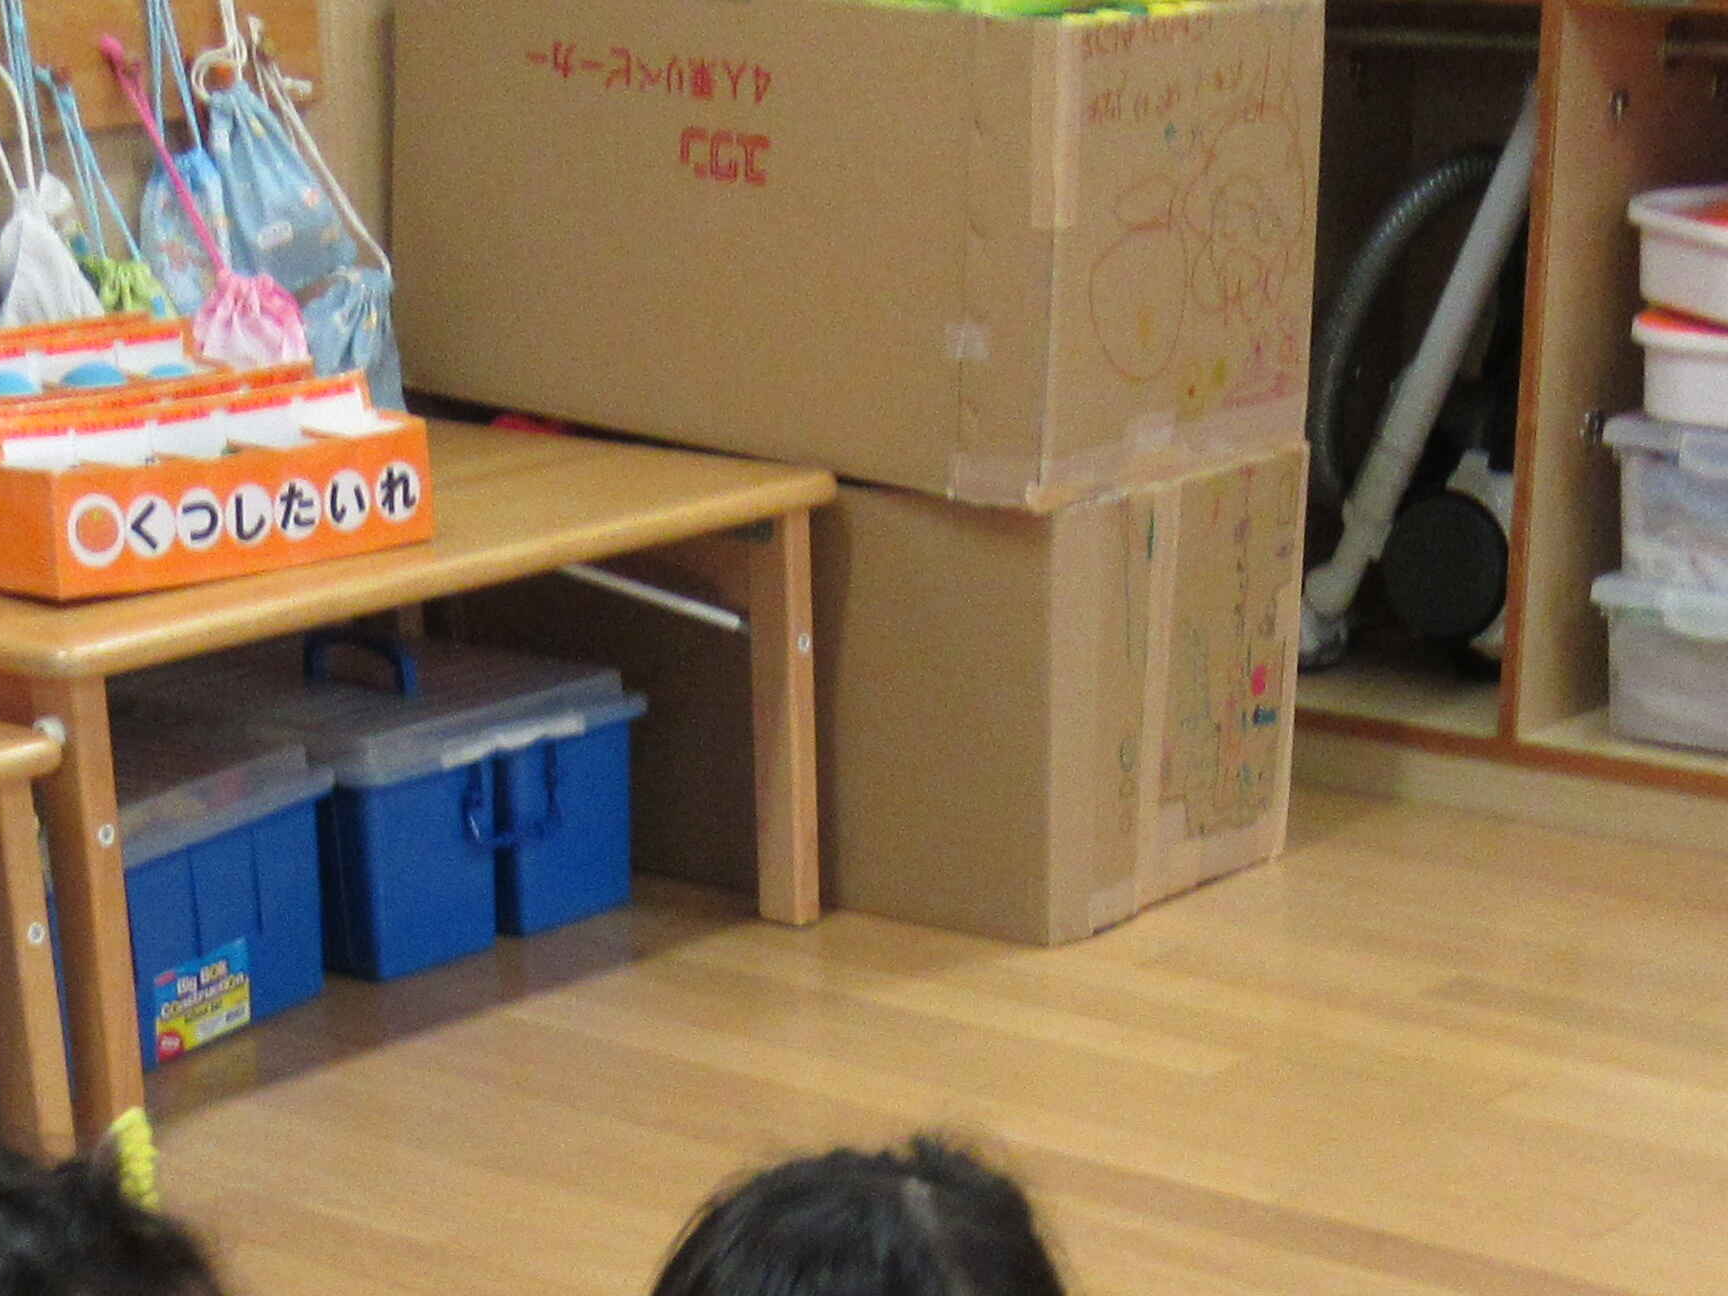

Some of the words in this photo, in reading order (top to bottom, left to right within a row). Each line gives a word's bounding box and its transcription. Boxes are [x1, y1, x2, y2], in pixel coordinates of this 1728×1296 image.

[129, 464, 417, 552] くつしたいれ
